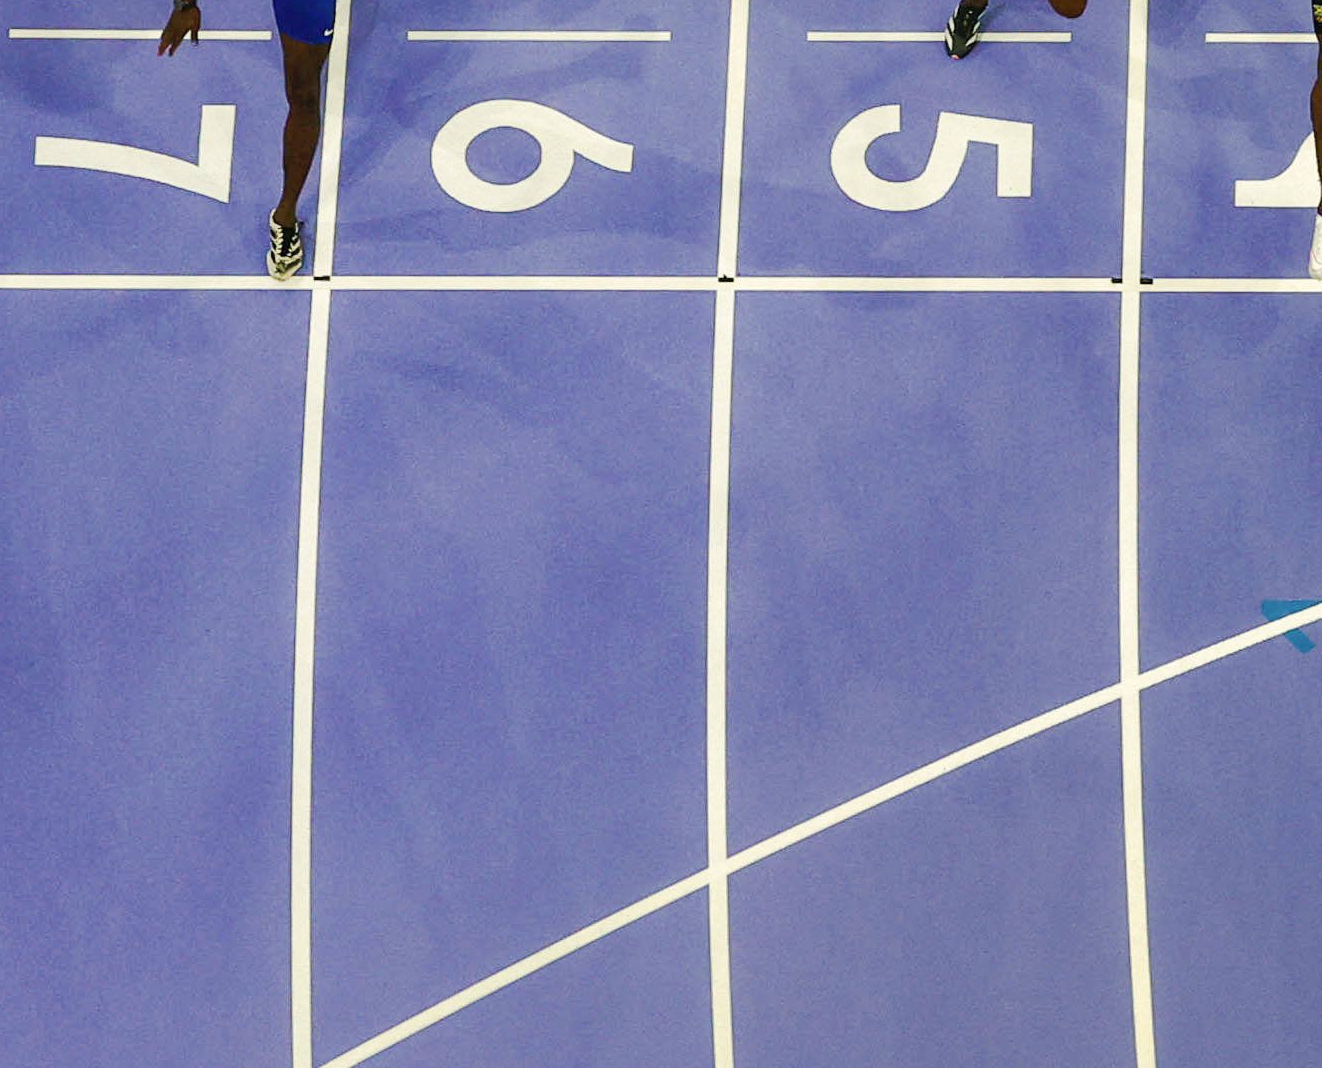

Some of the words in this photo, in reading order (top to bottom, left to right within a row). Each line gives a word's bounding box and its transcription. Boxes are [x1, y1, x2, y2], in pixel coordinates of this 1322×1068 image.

[34, 104, 236, 203] 7
[431, 99, 634, 213] 6
[830, 104, 1034, 212] 5
